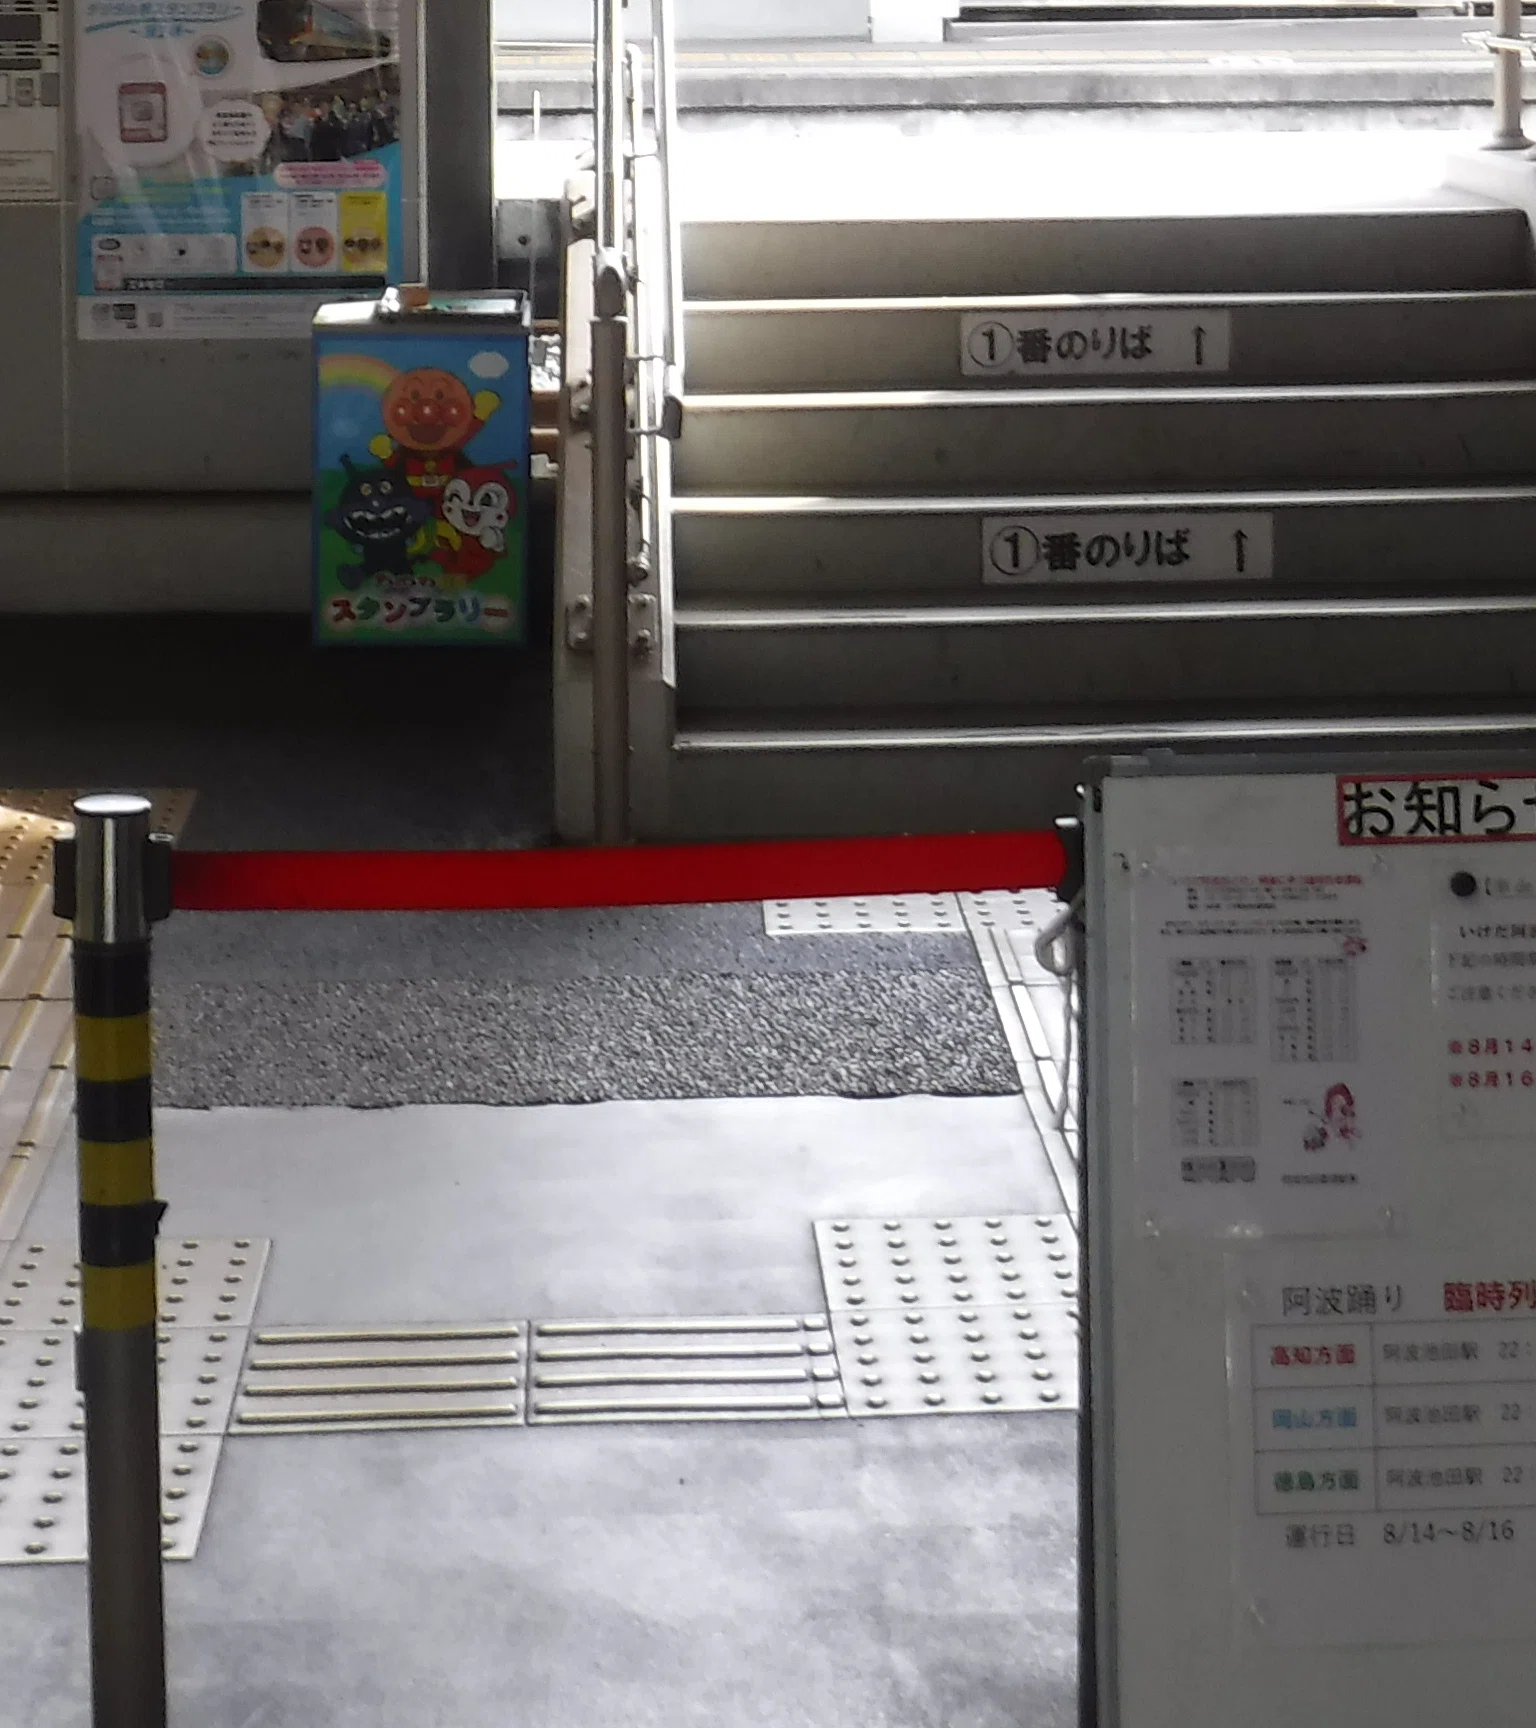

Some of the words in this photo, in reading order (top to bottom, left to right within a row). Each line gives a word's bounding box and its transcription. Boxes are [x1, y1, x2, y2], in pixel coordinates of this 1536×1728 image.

[331, 595, 509, 624] スタンプラリー
[1281, 1284, 1405, 1318] 阿波踊り
[1269, 1343, 1357, 1367] 高知方面
